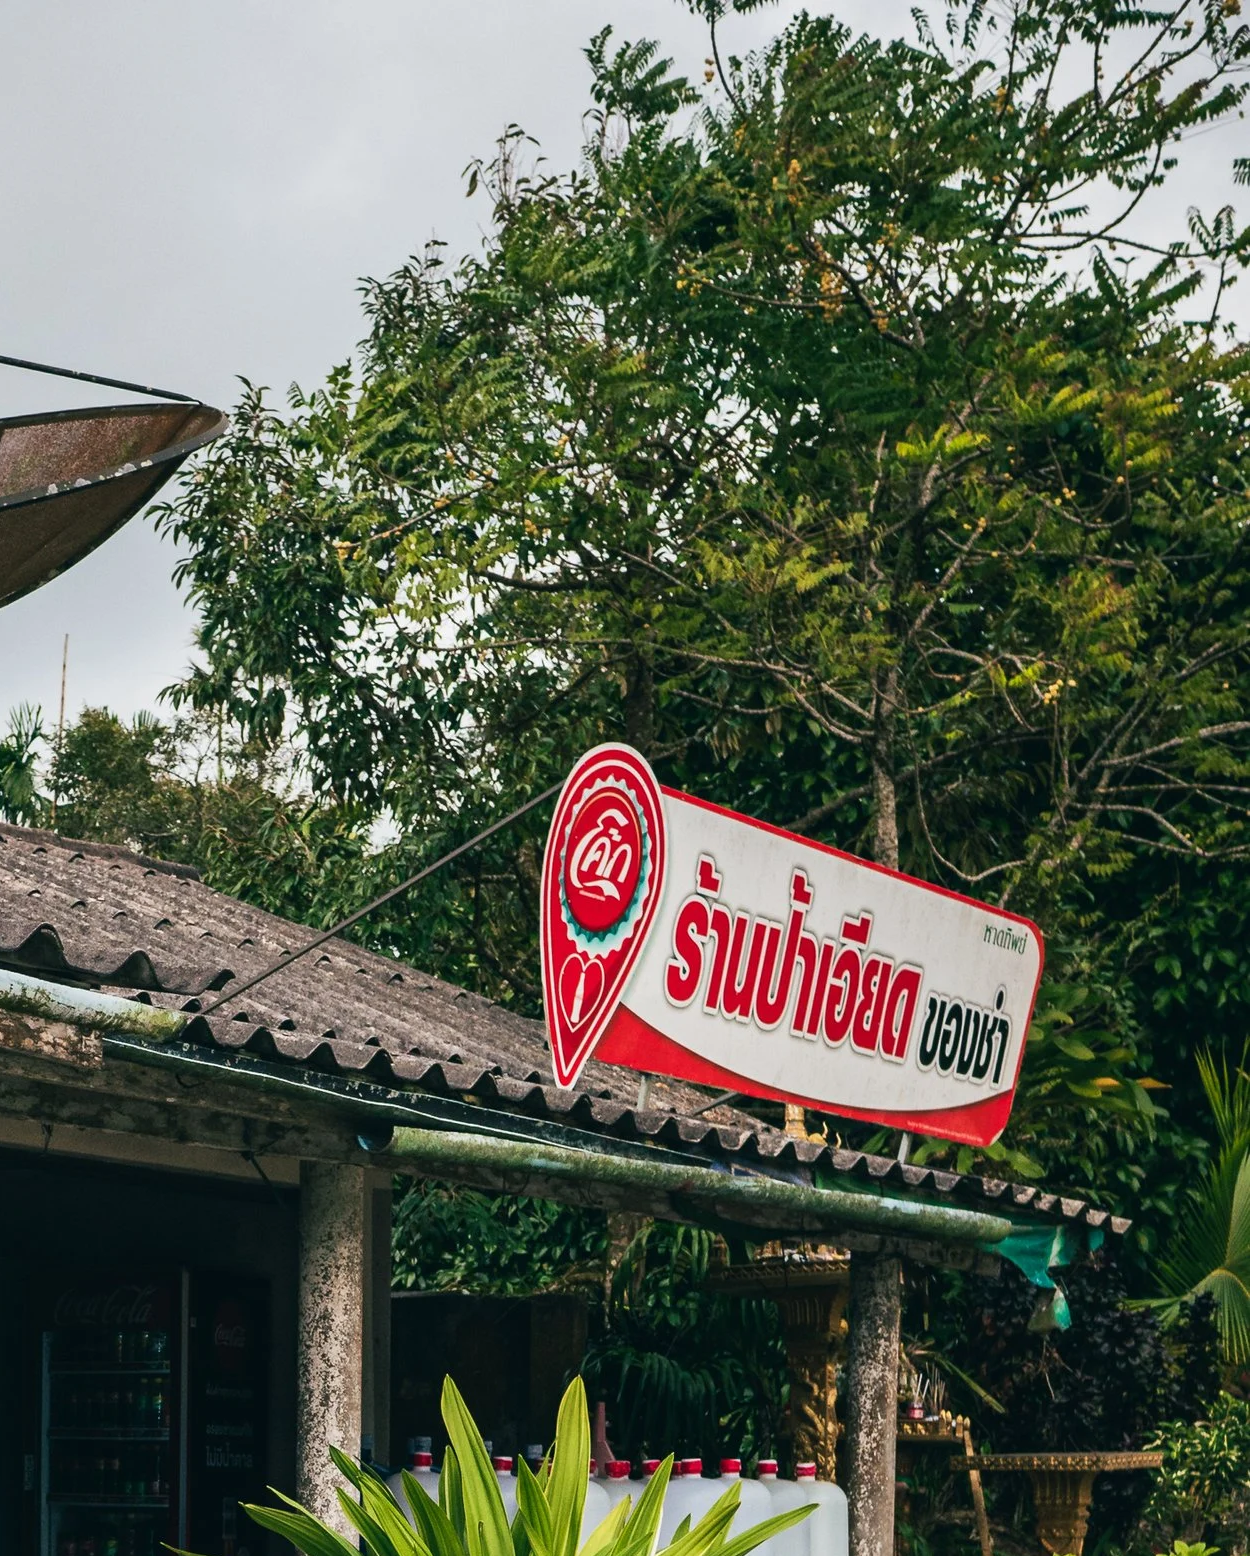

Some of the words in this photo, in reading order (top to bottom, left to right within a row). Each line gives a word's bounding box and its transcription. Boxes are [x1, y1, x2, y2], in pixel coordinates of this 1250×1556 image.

[666, 857, 922, 1061] ร้านป้าเอียด
[919, 988, 1010, 1085] ของชำ
[983, 924, 1028, 955] หาดทิพย์
